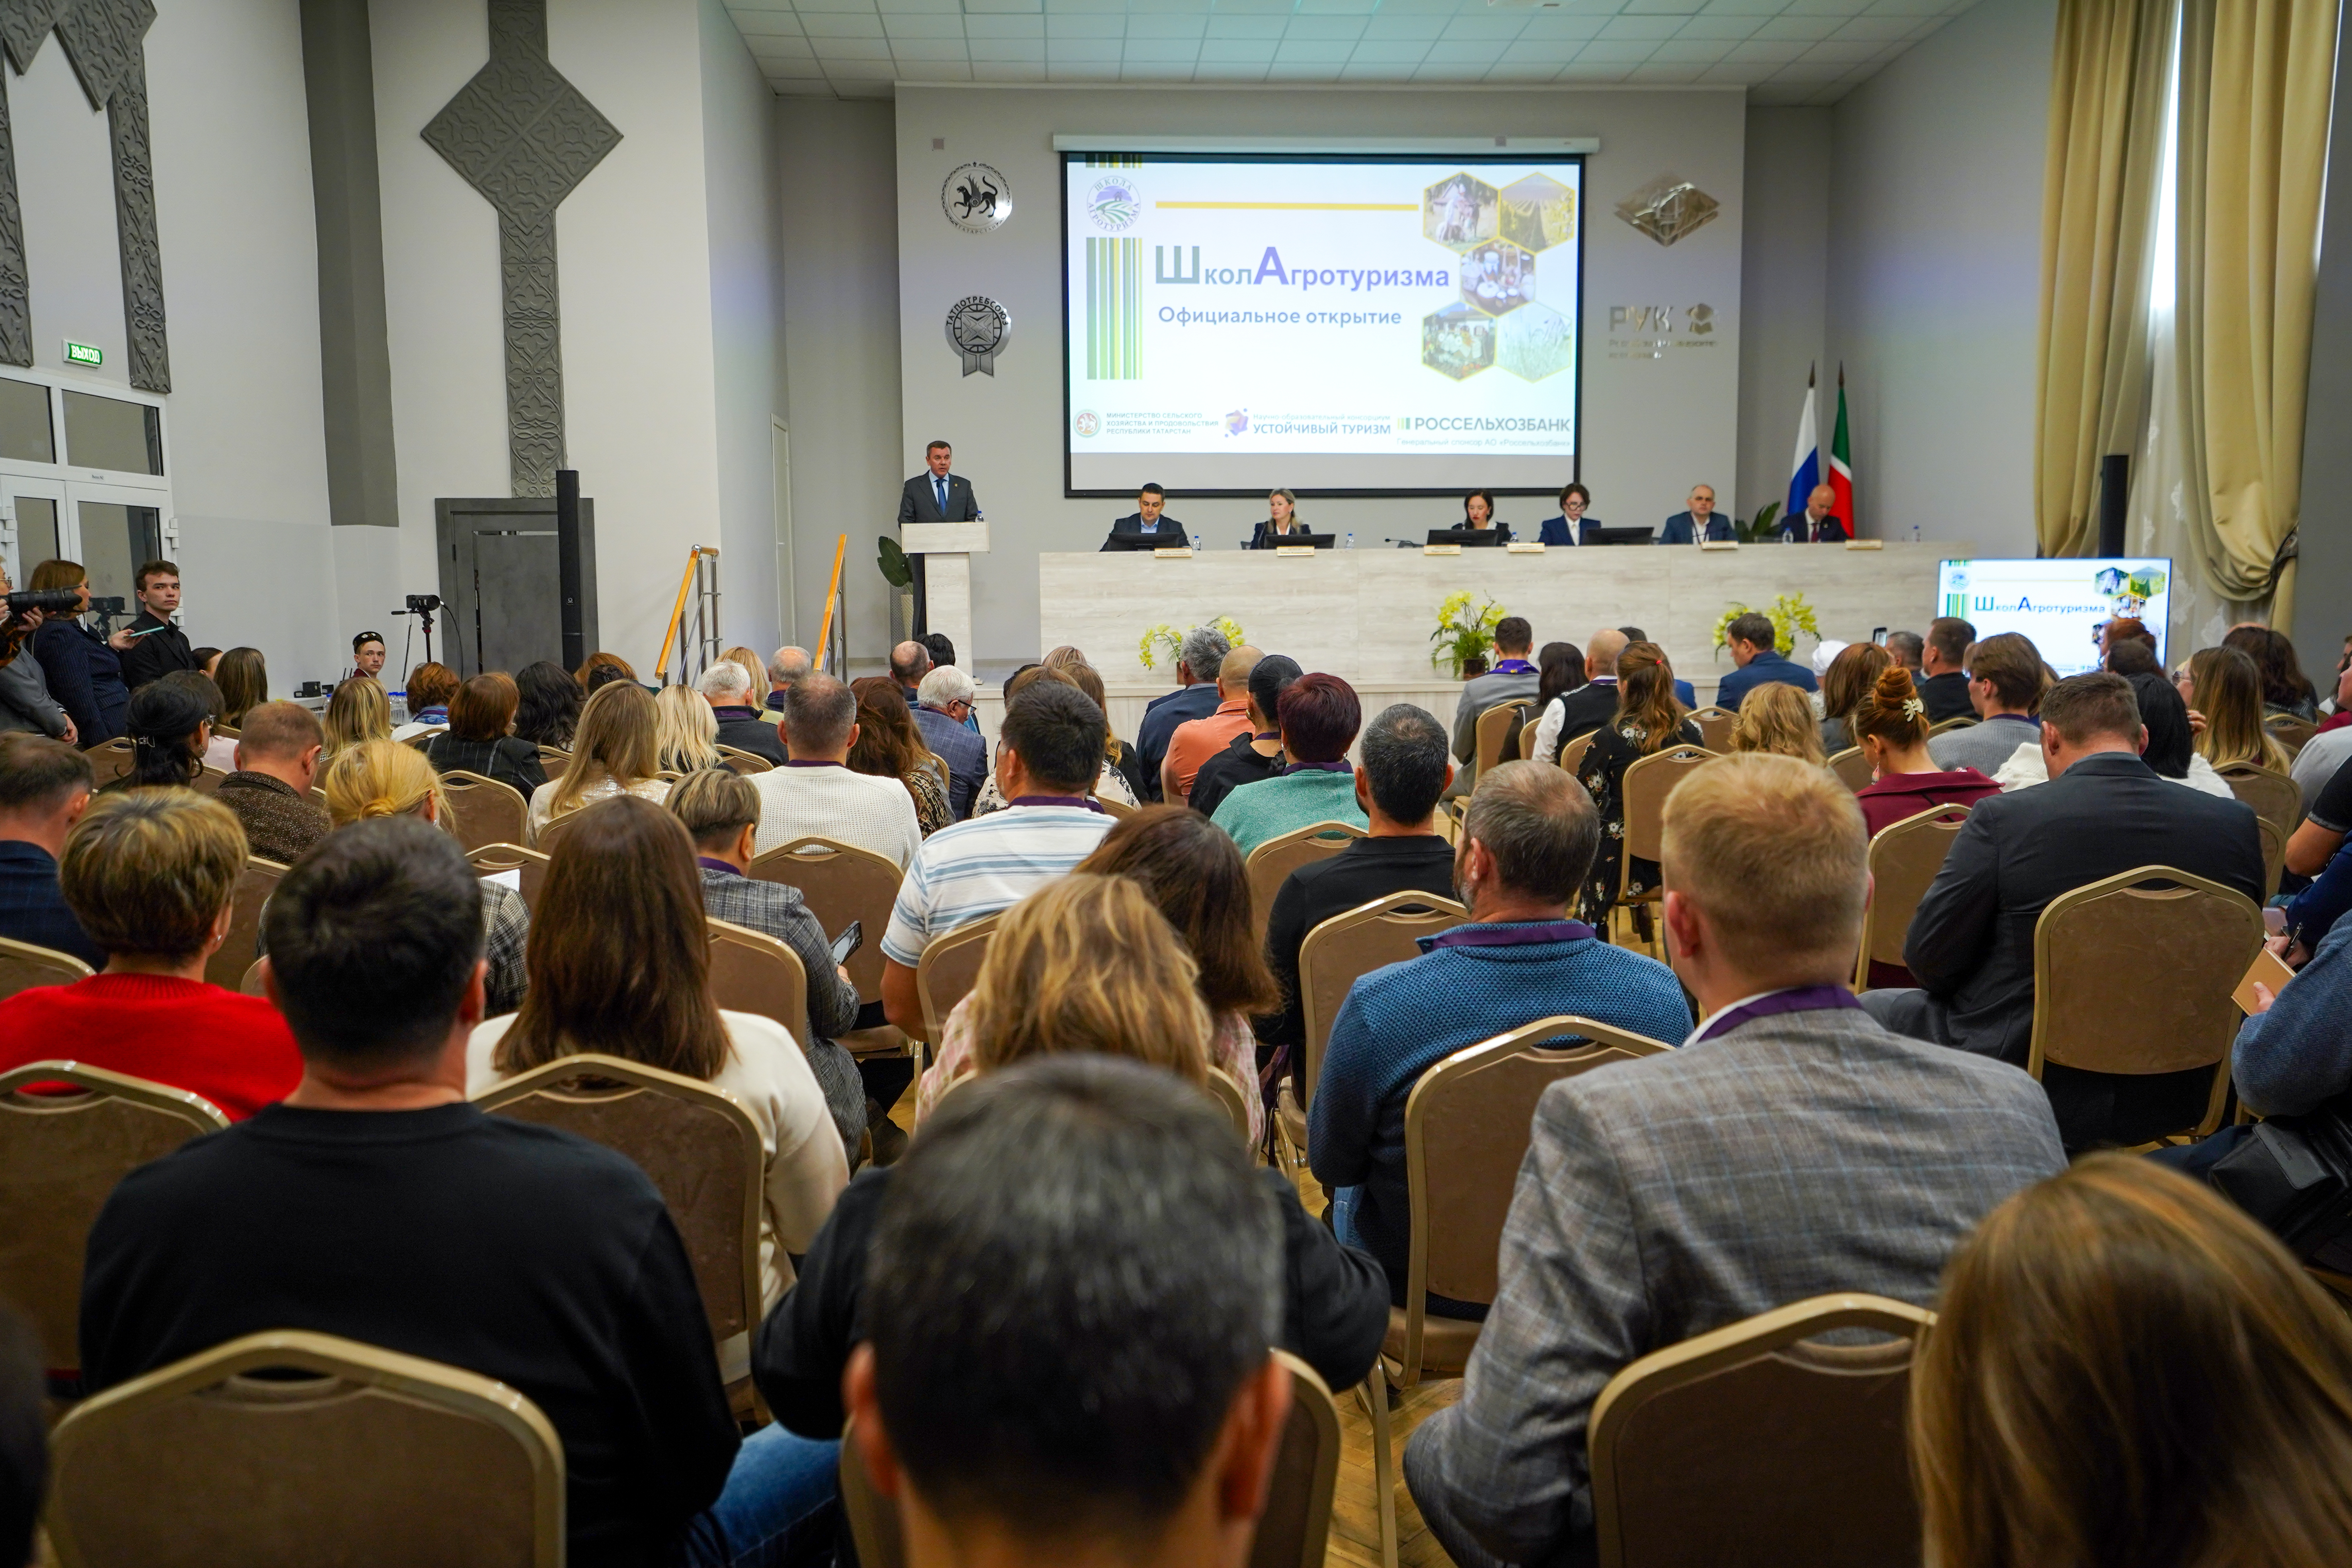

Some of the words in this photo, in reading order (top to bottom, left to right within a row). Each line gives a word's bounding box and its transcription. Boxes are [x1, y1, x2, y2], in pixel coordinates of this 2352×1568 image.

[1095, 178, 1132, 191] ШКОЛА
[1088, 203, 1140, 231] АГРОТУРИЗМА
[946, 296, 1009, 326] ТАТПОТРЕБСОЮЗ
[1158, 306, 1301, 327] Официальное
[1306, 310, 1401, 328] открытие
[71, 345, 100, 364] ВЫХОД
[1253, 422, 1338, 434] УСТОЙЧИВЫЙ
[1341, 424, 1391, 434] ТУРИЗМ
[1415, 417, 1571, 432] РОССЕЛЬХОЗБАНК
